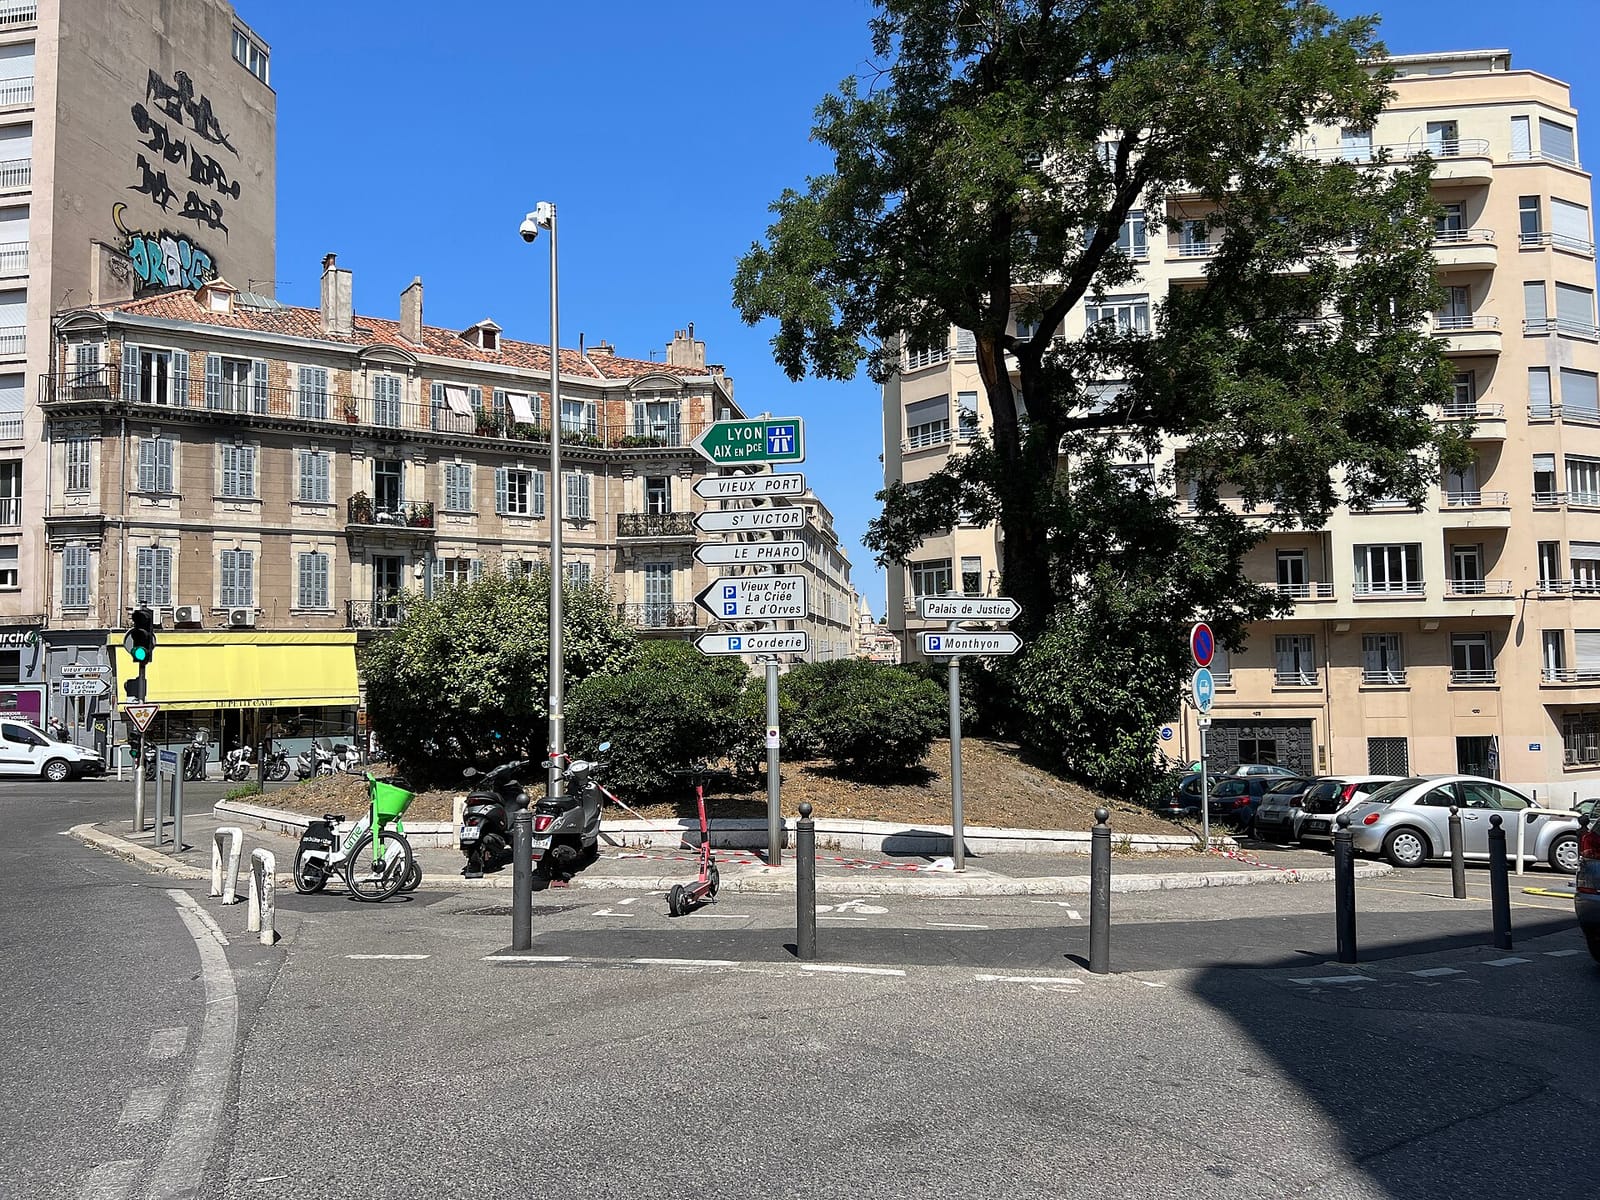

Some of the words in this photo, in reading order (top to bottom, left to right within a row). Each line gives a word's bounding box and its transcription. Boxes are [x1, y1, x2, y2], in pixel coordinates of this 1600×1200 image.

[727, 426, 763, 441] LYON
[713, 444, 732, 458] AIX
[734, 448, 744, 457] EN
[719, 481, 756, 493] VIEUX
[765, 479, 799, 491] PORT
[752, 512, 799, 525] VICTOR
[734, 548, 748, 559] LE
[757, 546, 800, 558] PHARO
[741, 581, 770, 592] Vieux
[773, 580, 796, 591] Port
[748, 592, 760, 602] La
[764, 590, 792, 601] Criée
[744, 604, 754, 615] E.
[760, 603, 801, 615] d'Orves
[928, 603, 957, 614] Palais
[961, 603, 973, 614] de
[976, 604, 1011, 614] Justice
[747, 637, 802, 648] Corderie
[944, 638, 999, 650] Monthyon
